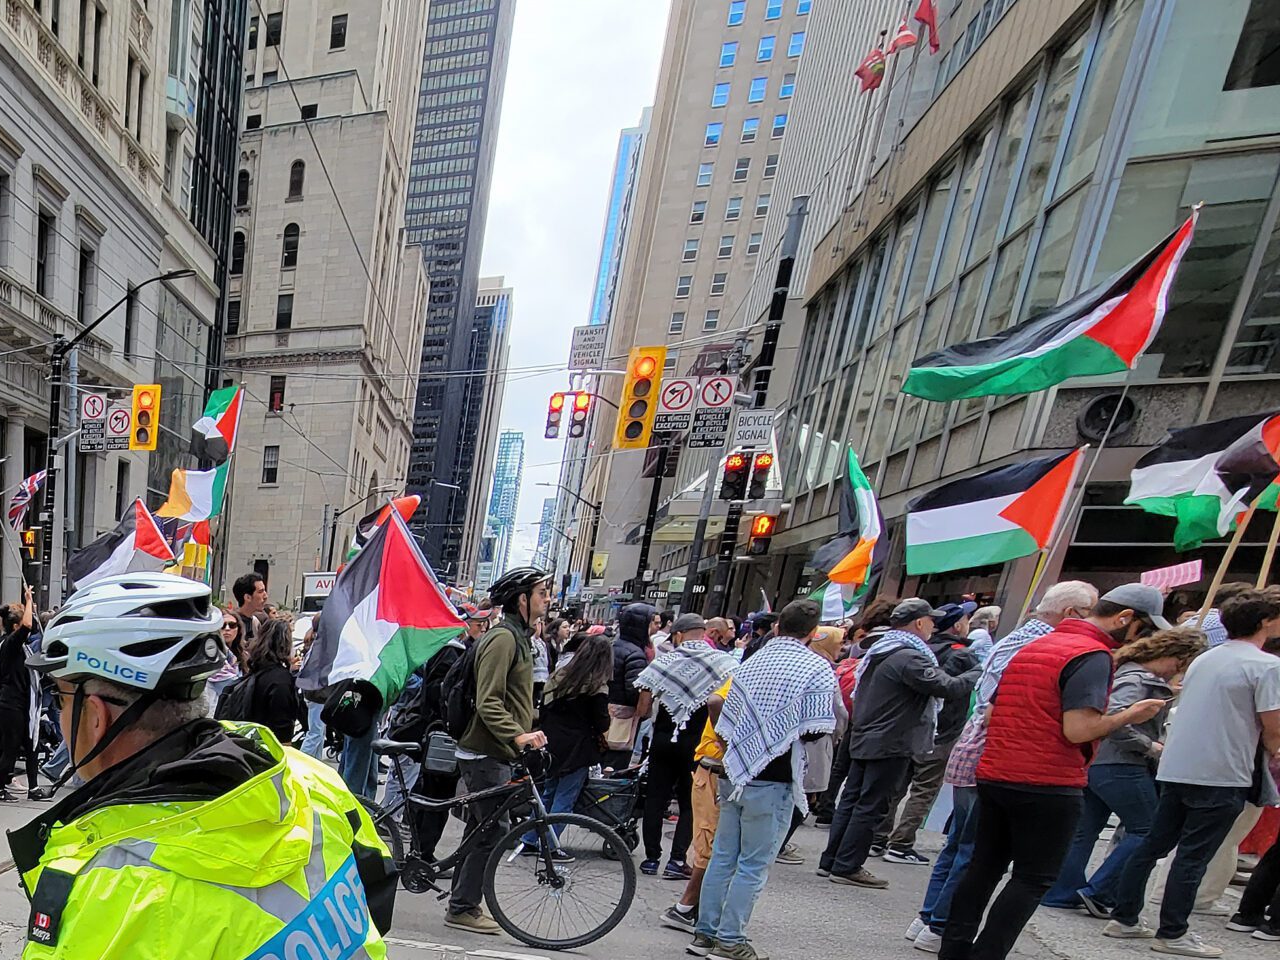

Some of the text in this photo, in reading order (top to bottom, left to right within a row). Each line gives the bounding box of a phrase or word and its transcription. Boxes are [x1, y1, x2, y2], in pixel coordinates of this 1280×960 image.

[576, 328, 605, 336] TRANSIT
[573, 350, 601, 358] VEHICLE
[573, 358, 598, 366] SIGNAL
[667, 414, 690, 422] VEHICLES
[738, 415, 773, 427] BICYCLE
[736, 430, 768, 440] SIGNAL
[692, 585, 706, 594] BO
[582, 592, 593, 601] 40
[76, 651, 149, 683] POLICE
